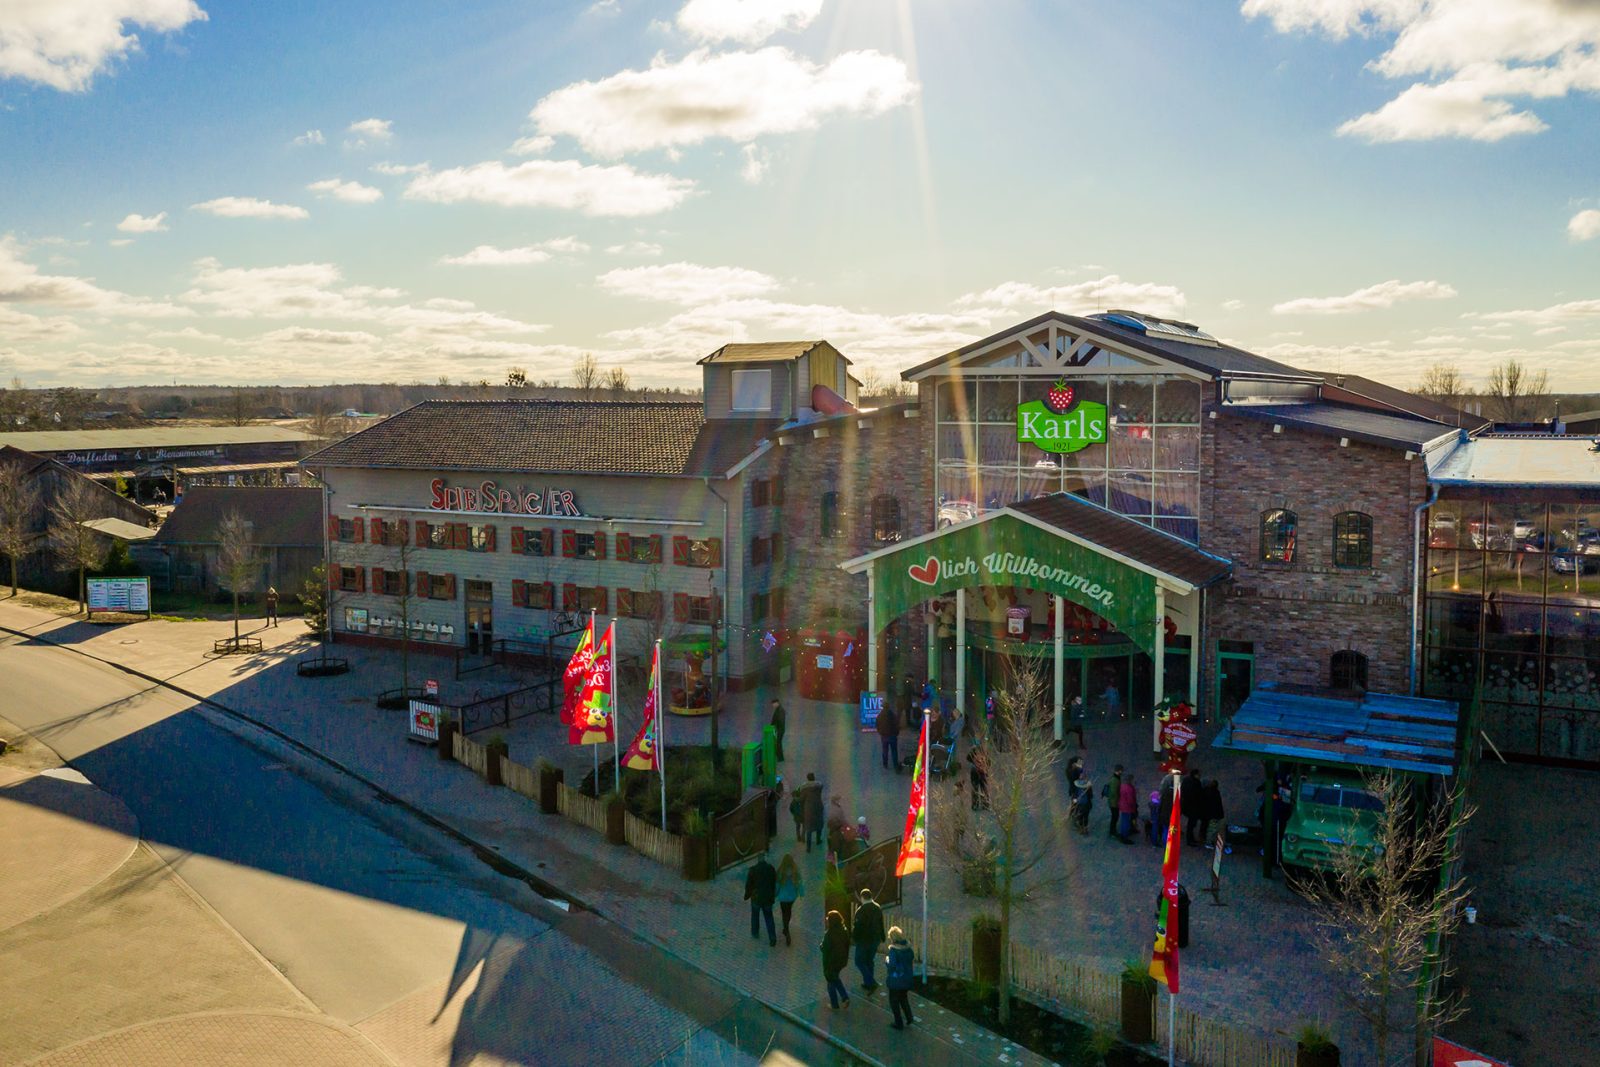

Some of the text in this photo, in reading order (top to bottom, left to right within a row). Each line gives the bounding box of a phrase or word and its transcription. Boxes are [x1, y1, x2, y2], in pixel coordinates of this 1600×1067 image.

[1021, 410, 1103, 440] Karls
[1053, 442, 1070, 451] 1921
[942, 552, 1114, 606] lich Willkommen
[863, 697, 884, 710] LIVE
